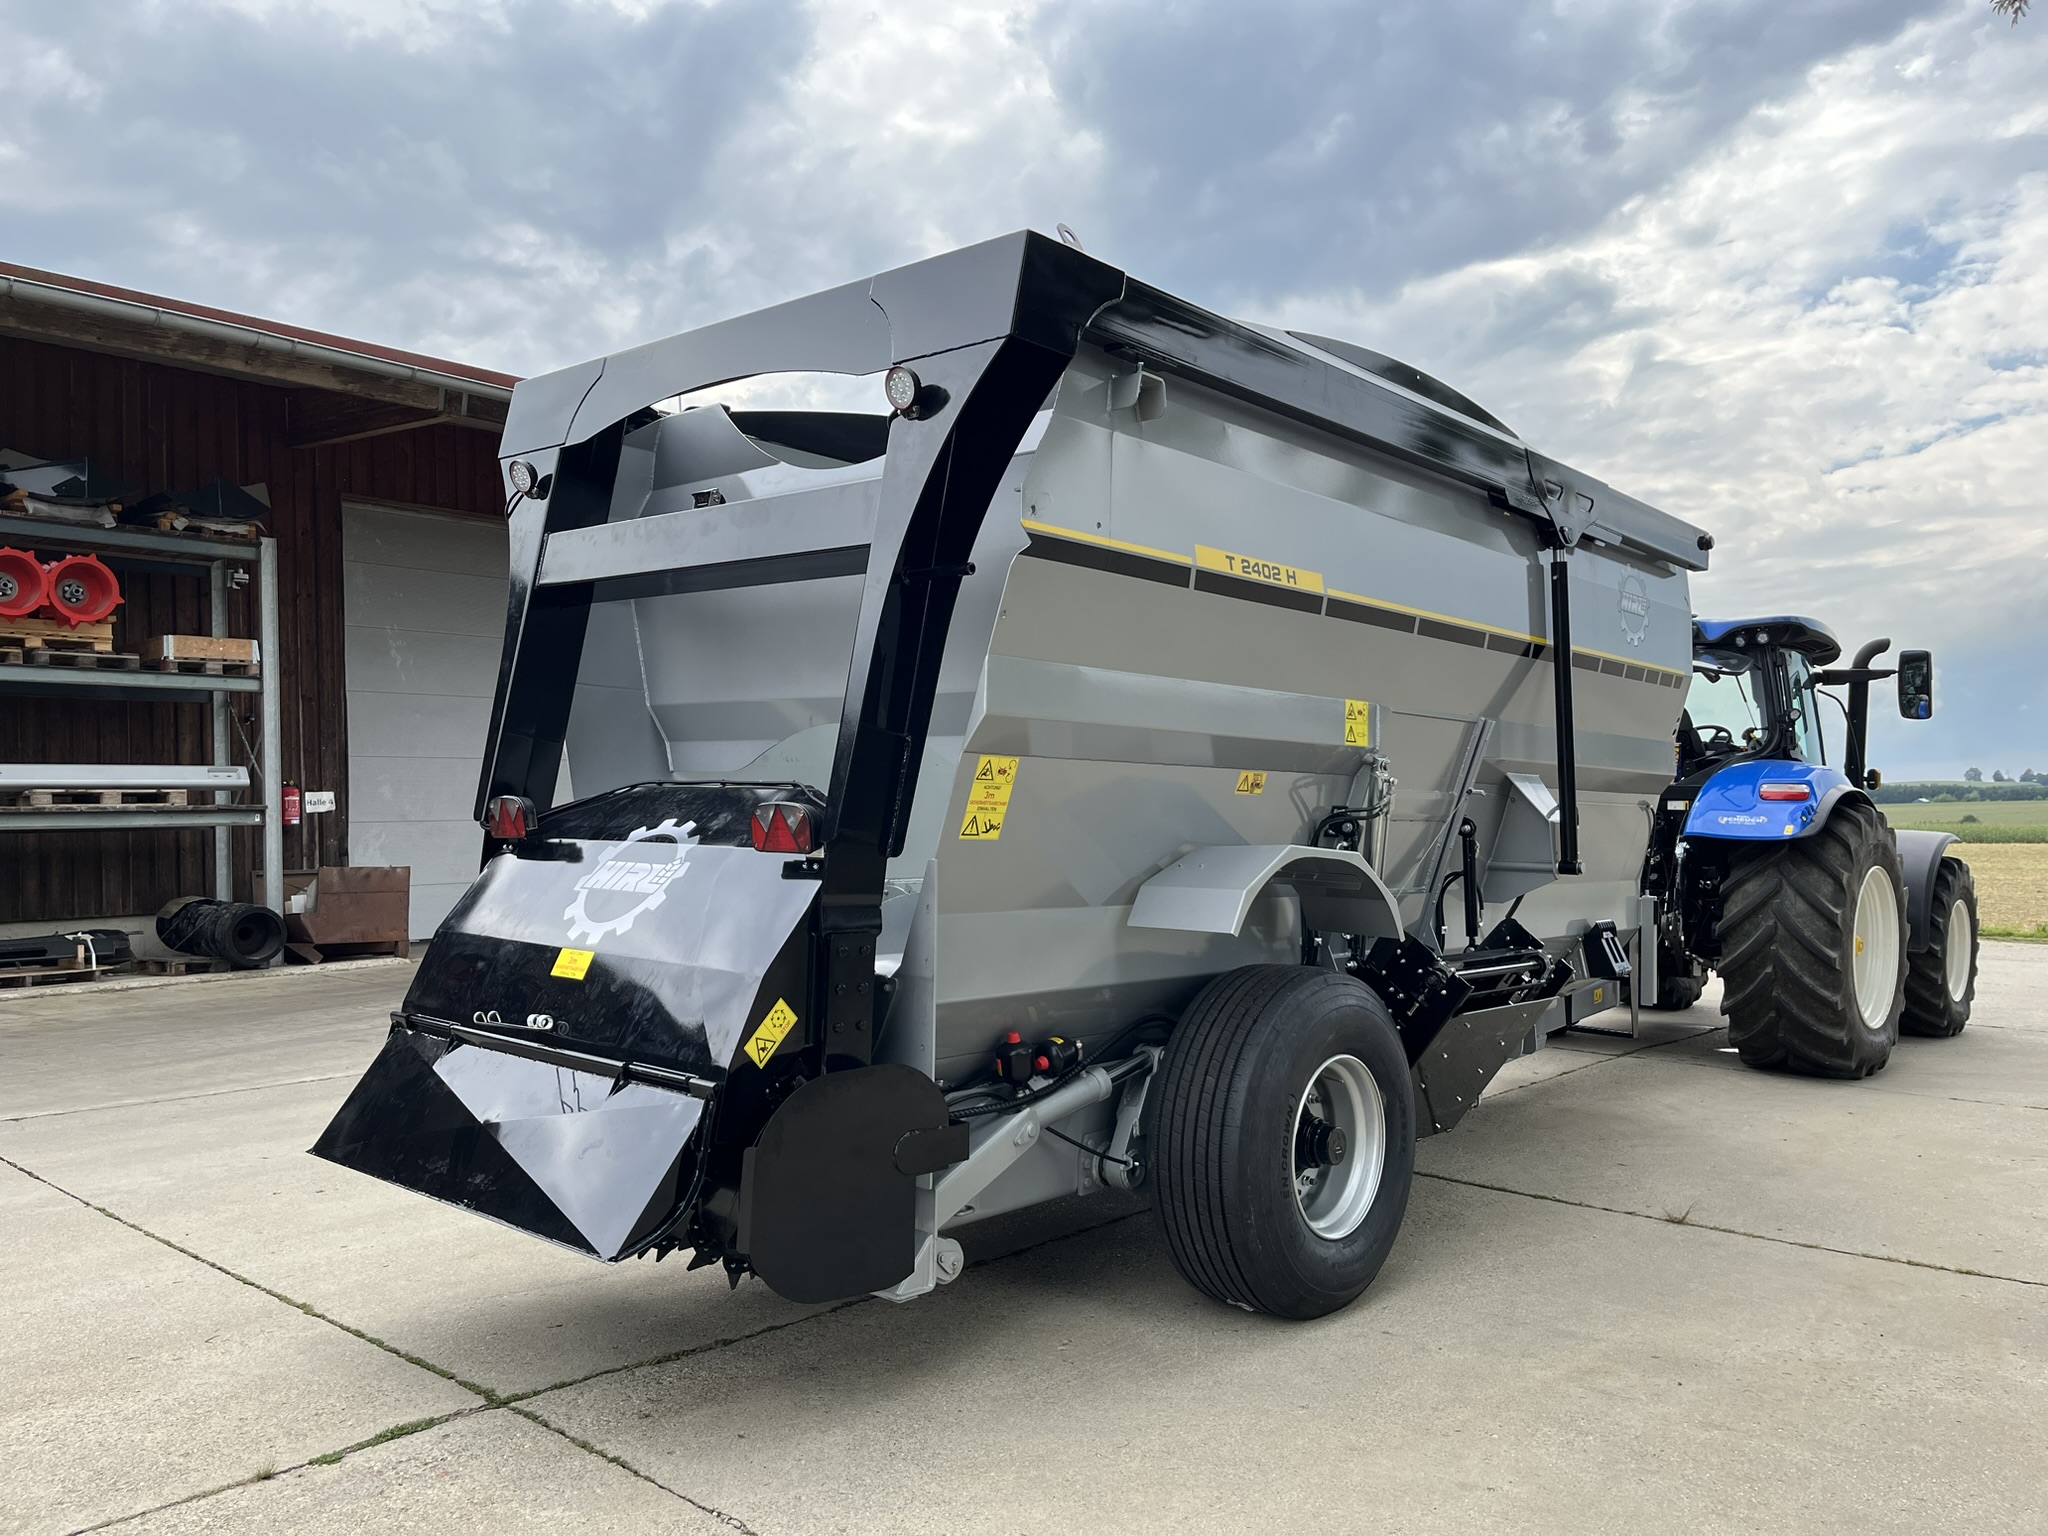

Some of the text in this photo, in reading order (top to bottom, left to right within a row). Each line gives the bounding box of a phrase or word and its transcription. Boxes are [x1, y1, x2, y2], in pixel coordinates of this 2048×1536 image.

[1225, 554, 1297, 586] T 2402 H
[984, 791, 995, 800] 3m
[306, 798, 327, 806] Halle
